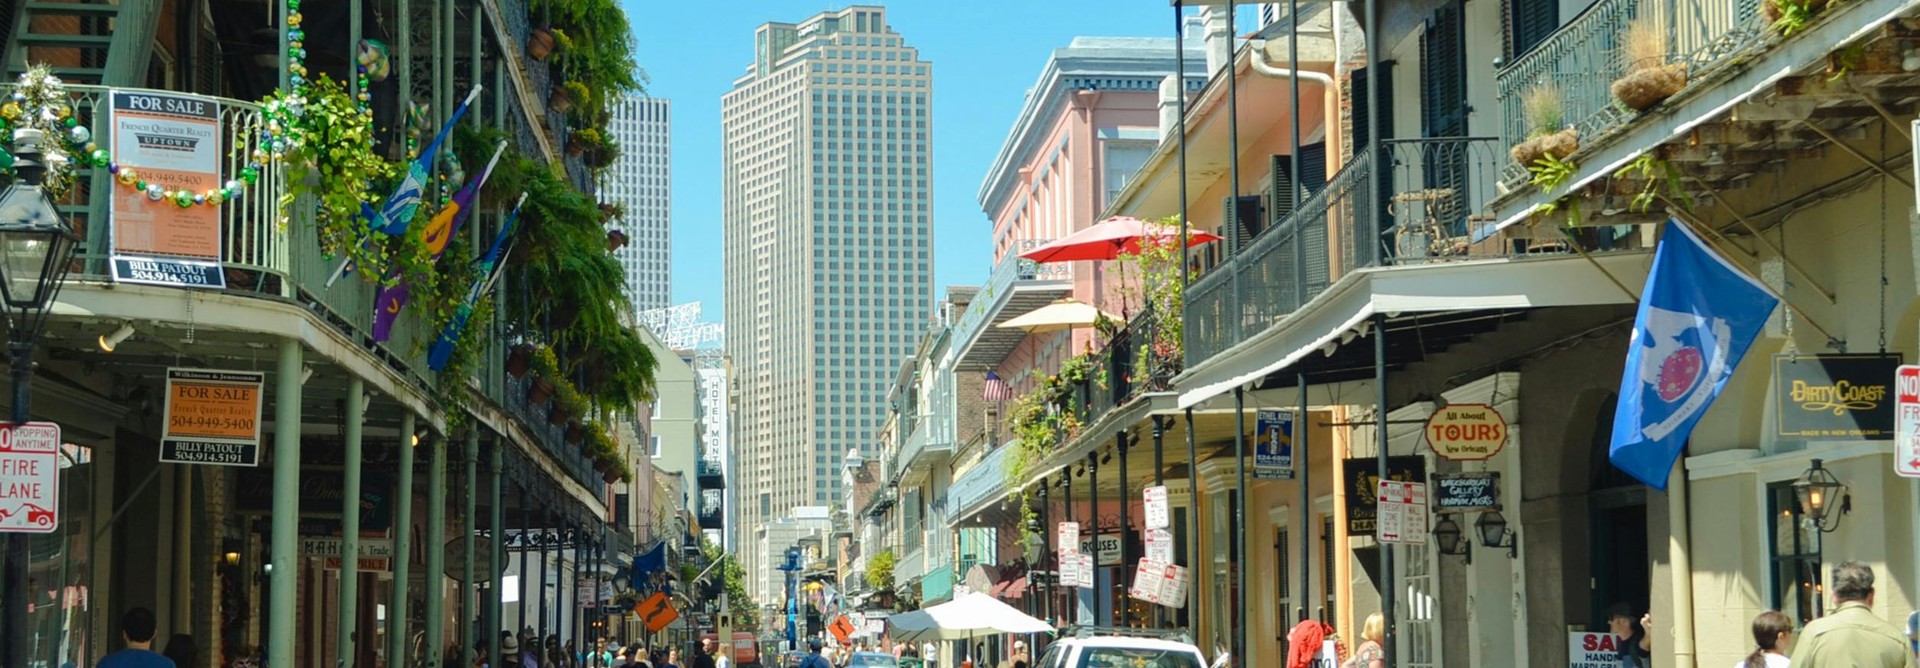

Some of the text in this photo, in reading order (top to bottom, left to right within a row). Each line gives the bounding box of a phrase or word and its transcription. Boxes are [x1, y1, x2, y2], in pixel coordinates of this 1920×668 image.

[129, 95, 205, 115] FOR SALE
[121, 121, 212, 138] FRENCH QUARTER REALTY
[144, 137, 191, 147] UPTOWN
[129, 260, 207, 275] BILLY PATOUT
[131, 270, 208, 284] 504.914.5191
[179, 386, 250, 400] FOR SALE
[1899, 375, 1918, 398] NO
[174, 403, 198, 413] French
[200, 405, 227, 415] Quarter
[711, 381, 720, 424] HOTEL
[171, 416, 254, 430] 504-949-5400
[1258, 412, 1293, 421] ETHEL KIDD
[1445, 411, 1486, 421] All About
[14, 427, 55, 438] STOPPING
[1432, 423, 1500, 442] TOURS
[16, 439, 53, 450] ANYTIME
[176, 442, 244, 453] BILLY PATOUT
[1445, 445, 1488, 453] New Orleans
[175, 451, 242, 462] 504.914.5191
[2, 459, 39, 476] FIRE
[0, 482, 42, 499] LANE
[1449, 486, 1484, 497] GALLERY
[1082, 539, 1118, 554] ROUSES
[327, 558, 343, 570] NE
